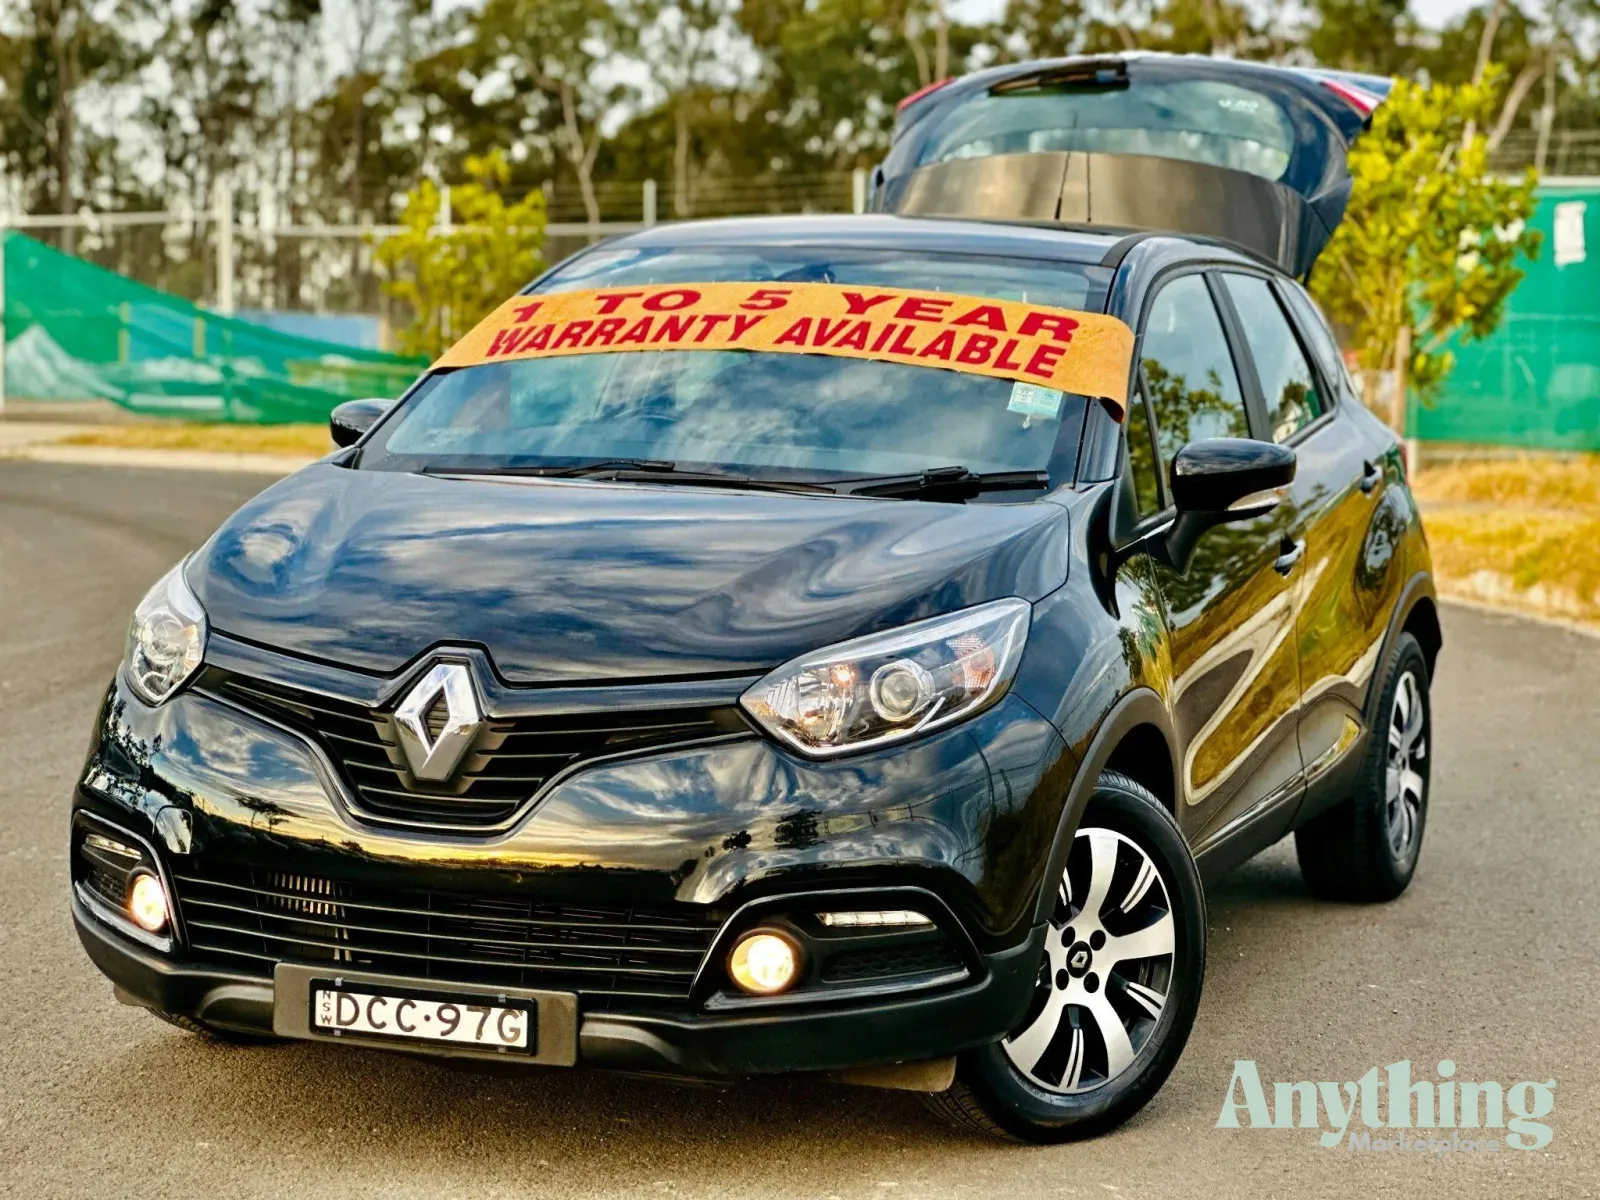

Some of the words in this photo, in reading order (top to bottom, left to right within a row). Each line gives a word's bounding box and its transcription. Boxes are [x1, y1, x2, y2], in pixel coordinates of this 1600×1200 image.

[512, 301, 543, 323] 1
[596, 289, 702, 316] TO
[738, 288, 793, 311] 5
[842, 292, 1080, 343] YEAR
[486, 314, 766, 357] WARRANTY
[773, 317, 1067, 379] AVAILABLE
